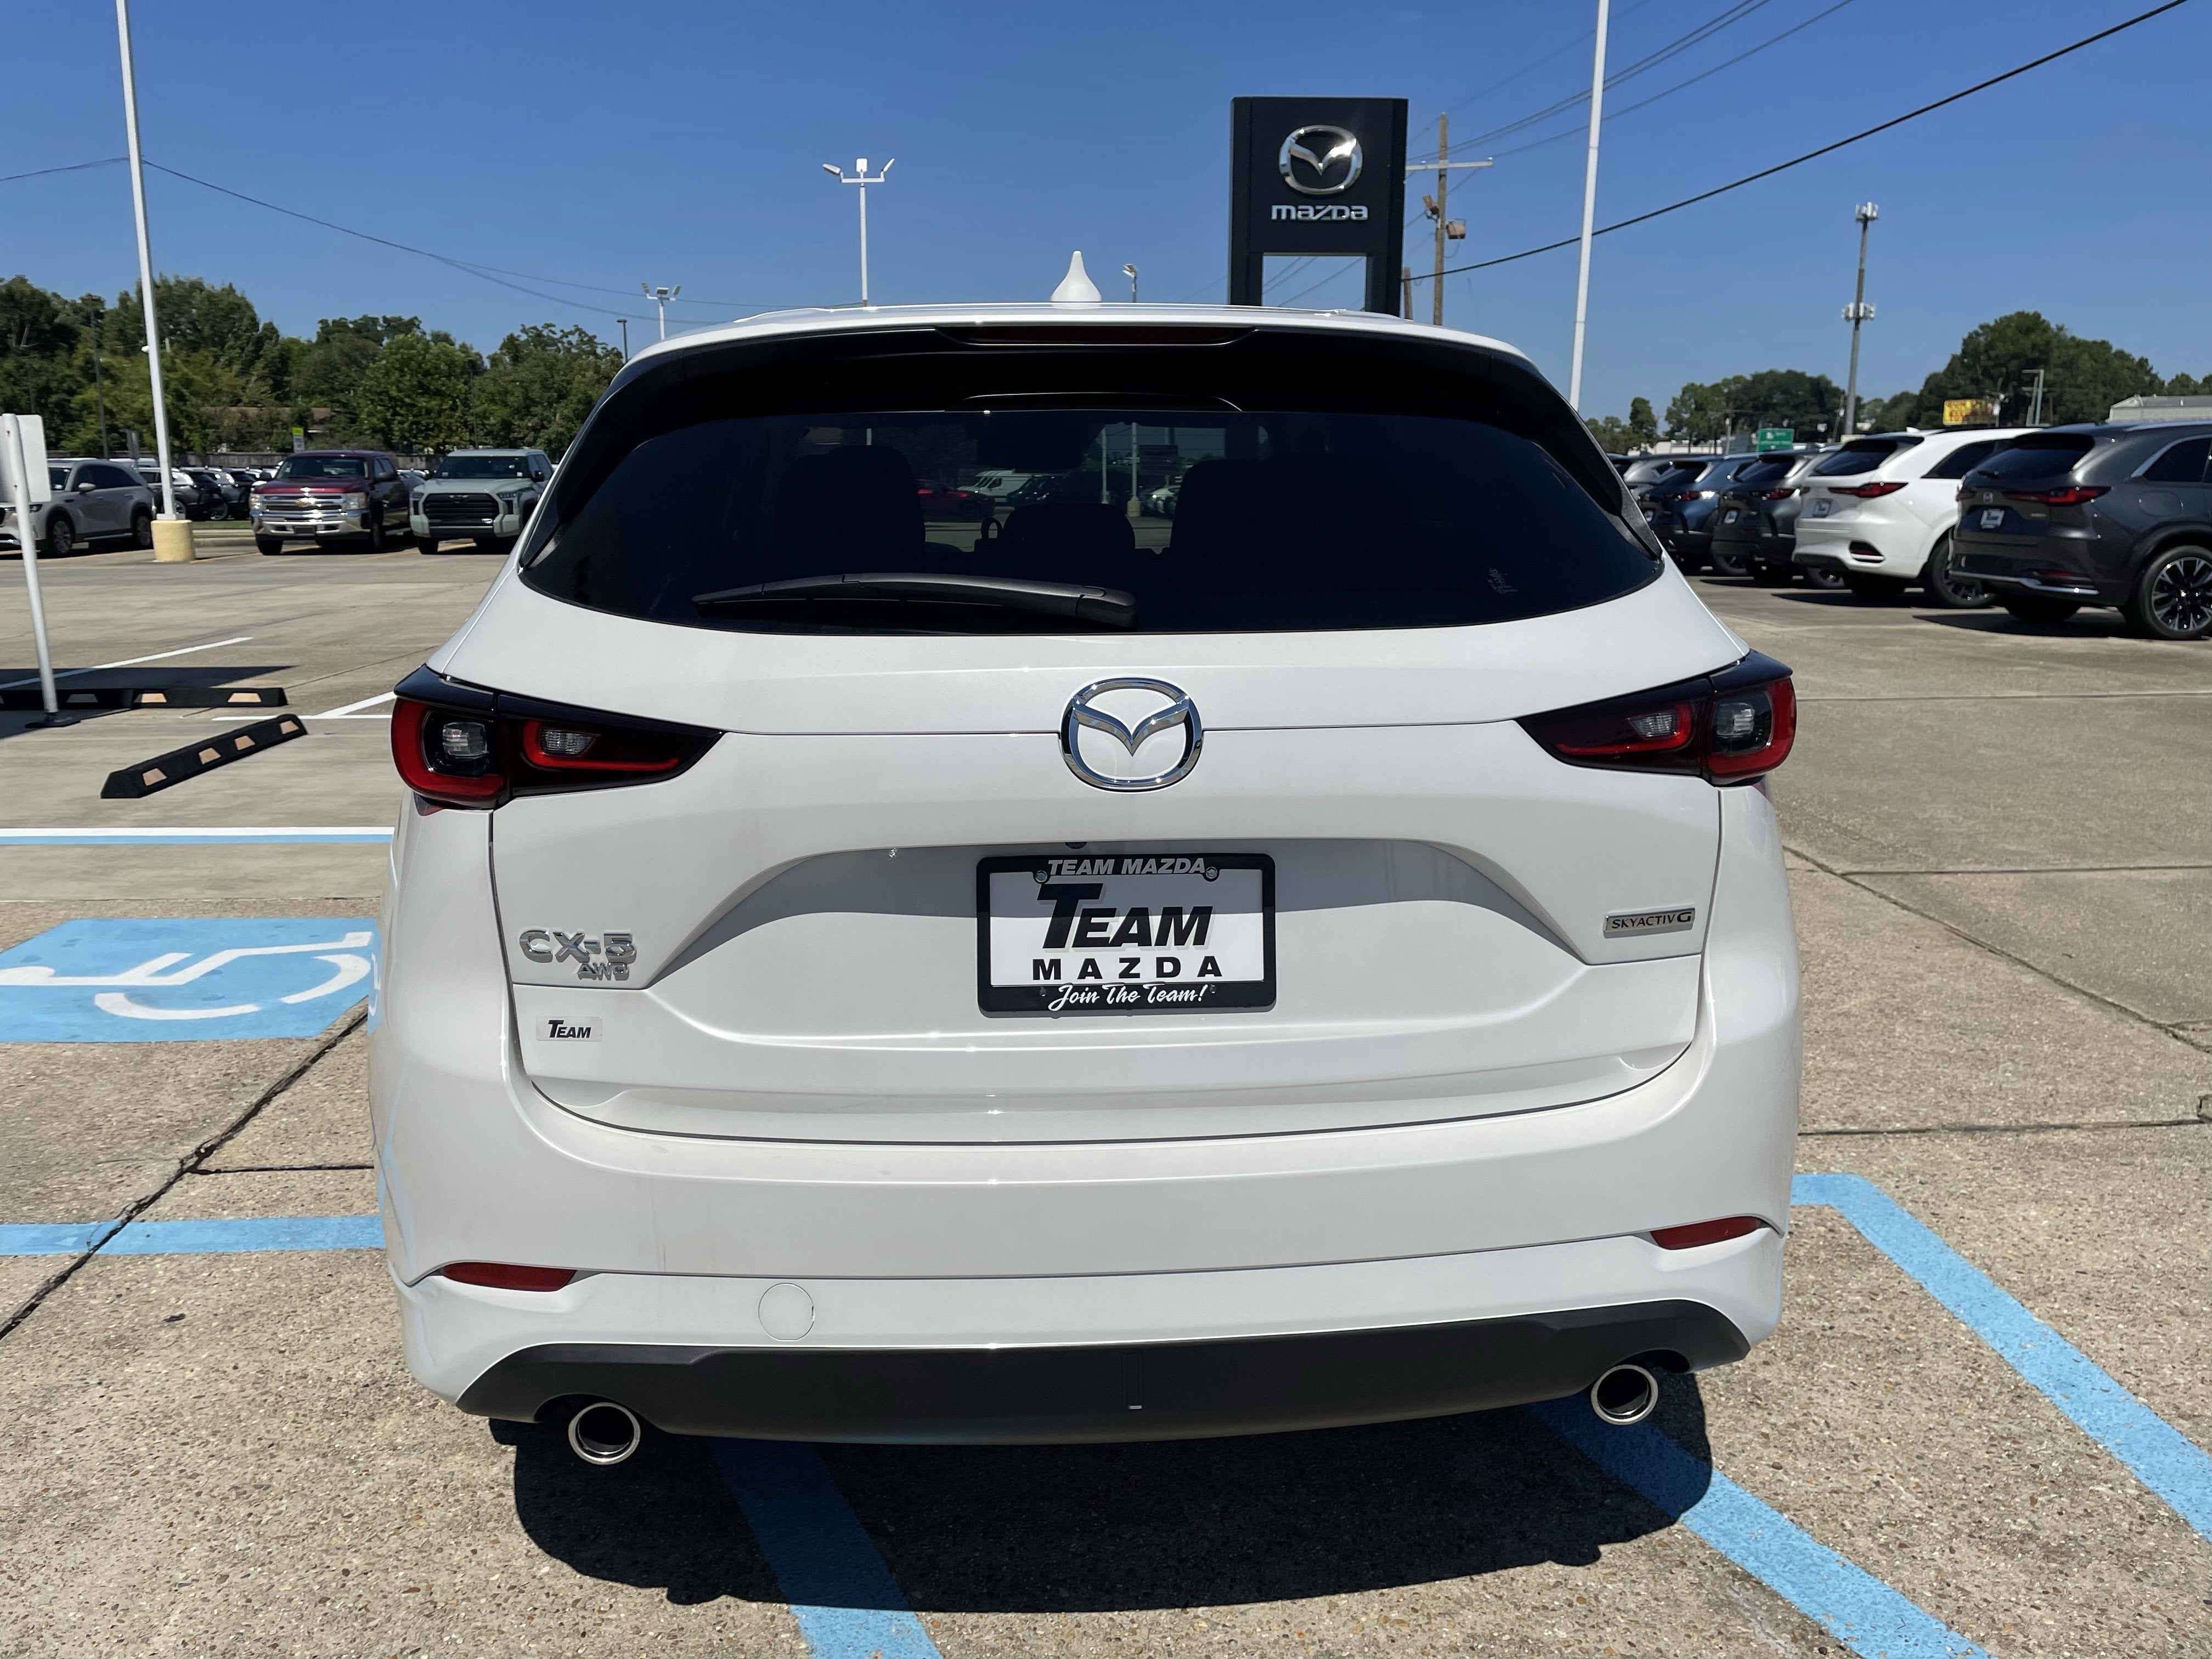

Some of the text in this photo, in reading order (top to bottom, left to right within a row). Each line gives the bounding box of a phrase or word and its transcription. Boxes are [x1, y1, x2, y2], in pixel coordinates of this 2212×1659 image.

[1048, 858, 1205, 875] TEAM MAZDA
[519, 929, 637, 964] CX-5
[577, 962, 630, 981] AWD
[1032, 955, 1222, 980] MAZDA
[1048, 983, 1208, 1011] Join The Team!
